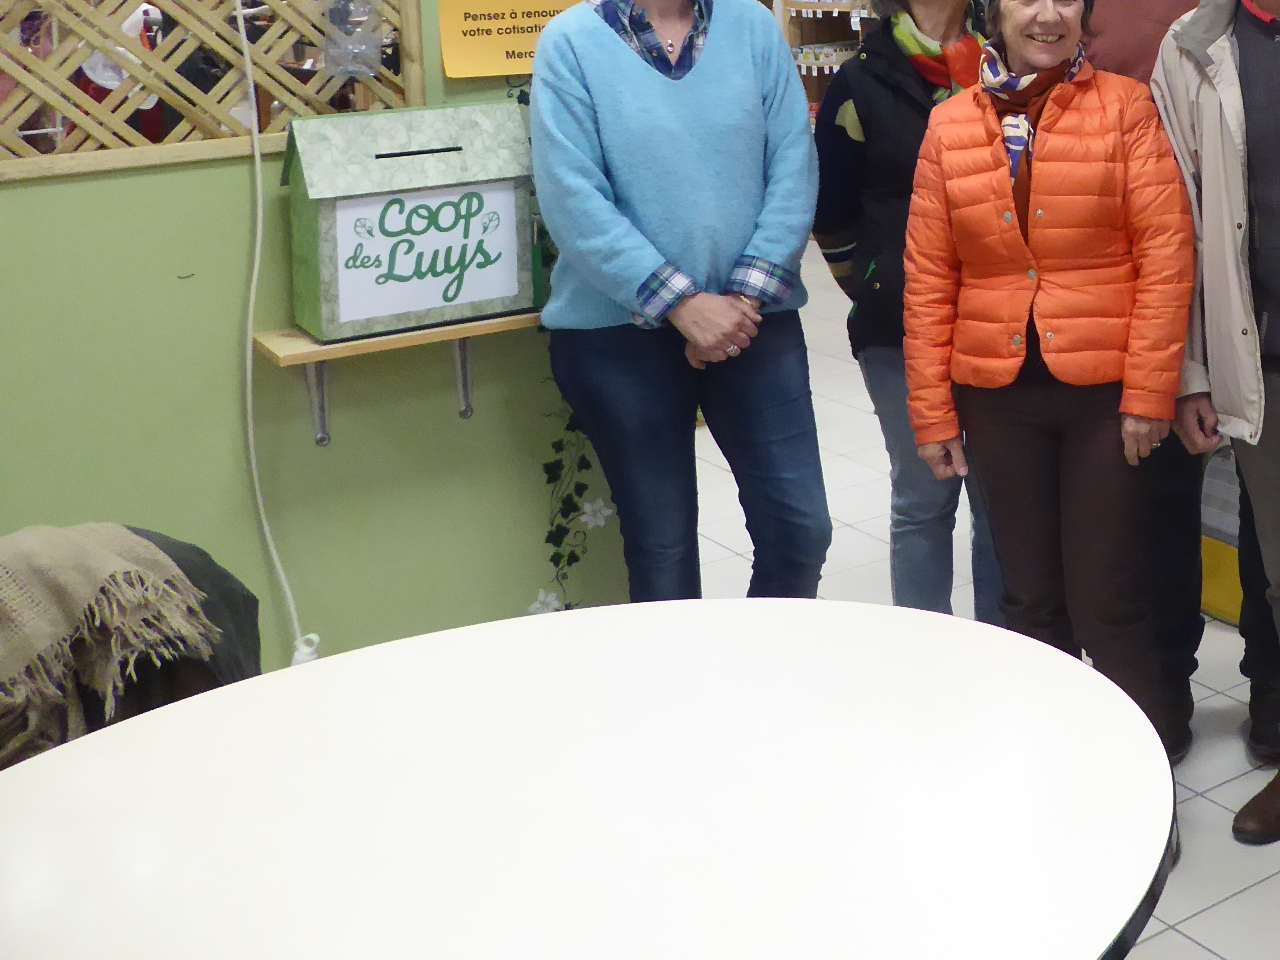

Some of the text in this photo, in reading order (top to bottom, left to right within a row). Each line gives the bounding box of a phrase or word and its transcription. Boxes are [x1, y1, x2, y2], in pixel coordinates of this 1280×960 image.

[463, 10, 506, 22] Pensez
[509, 9, 518, 19] à
[462, 27, 493, 37] votre
[505, 50, 536, 60] Merc
[344, 239, 502, 303] des Luys
